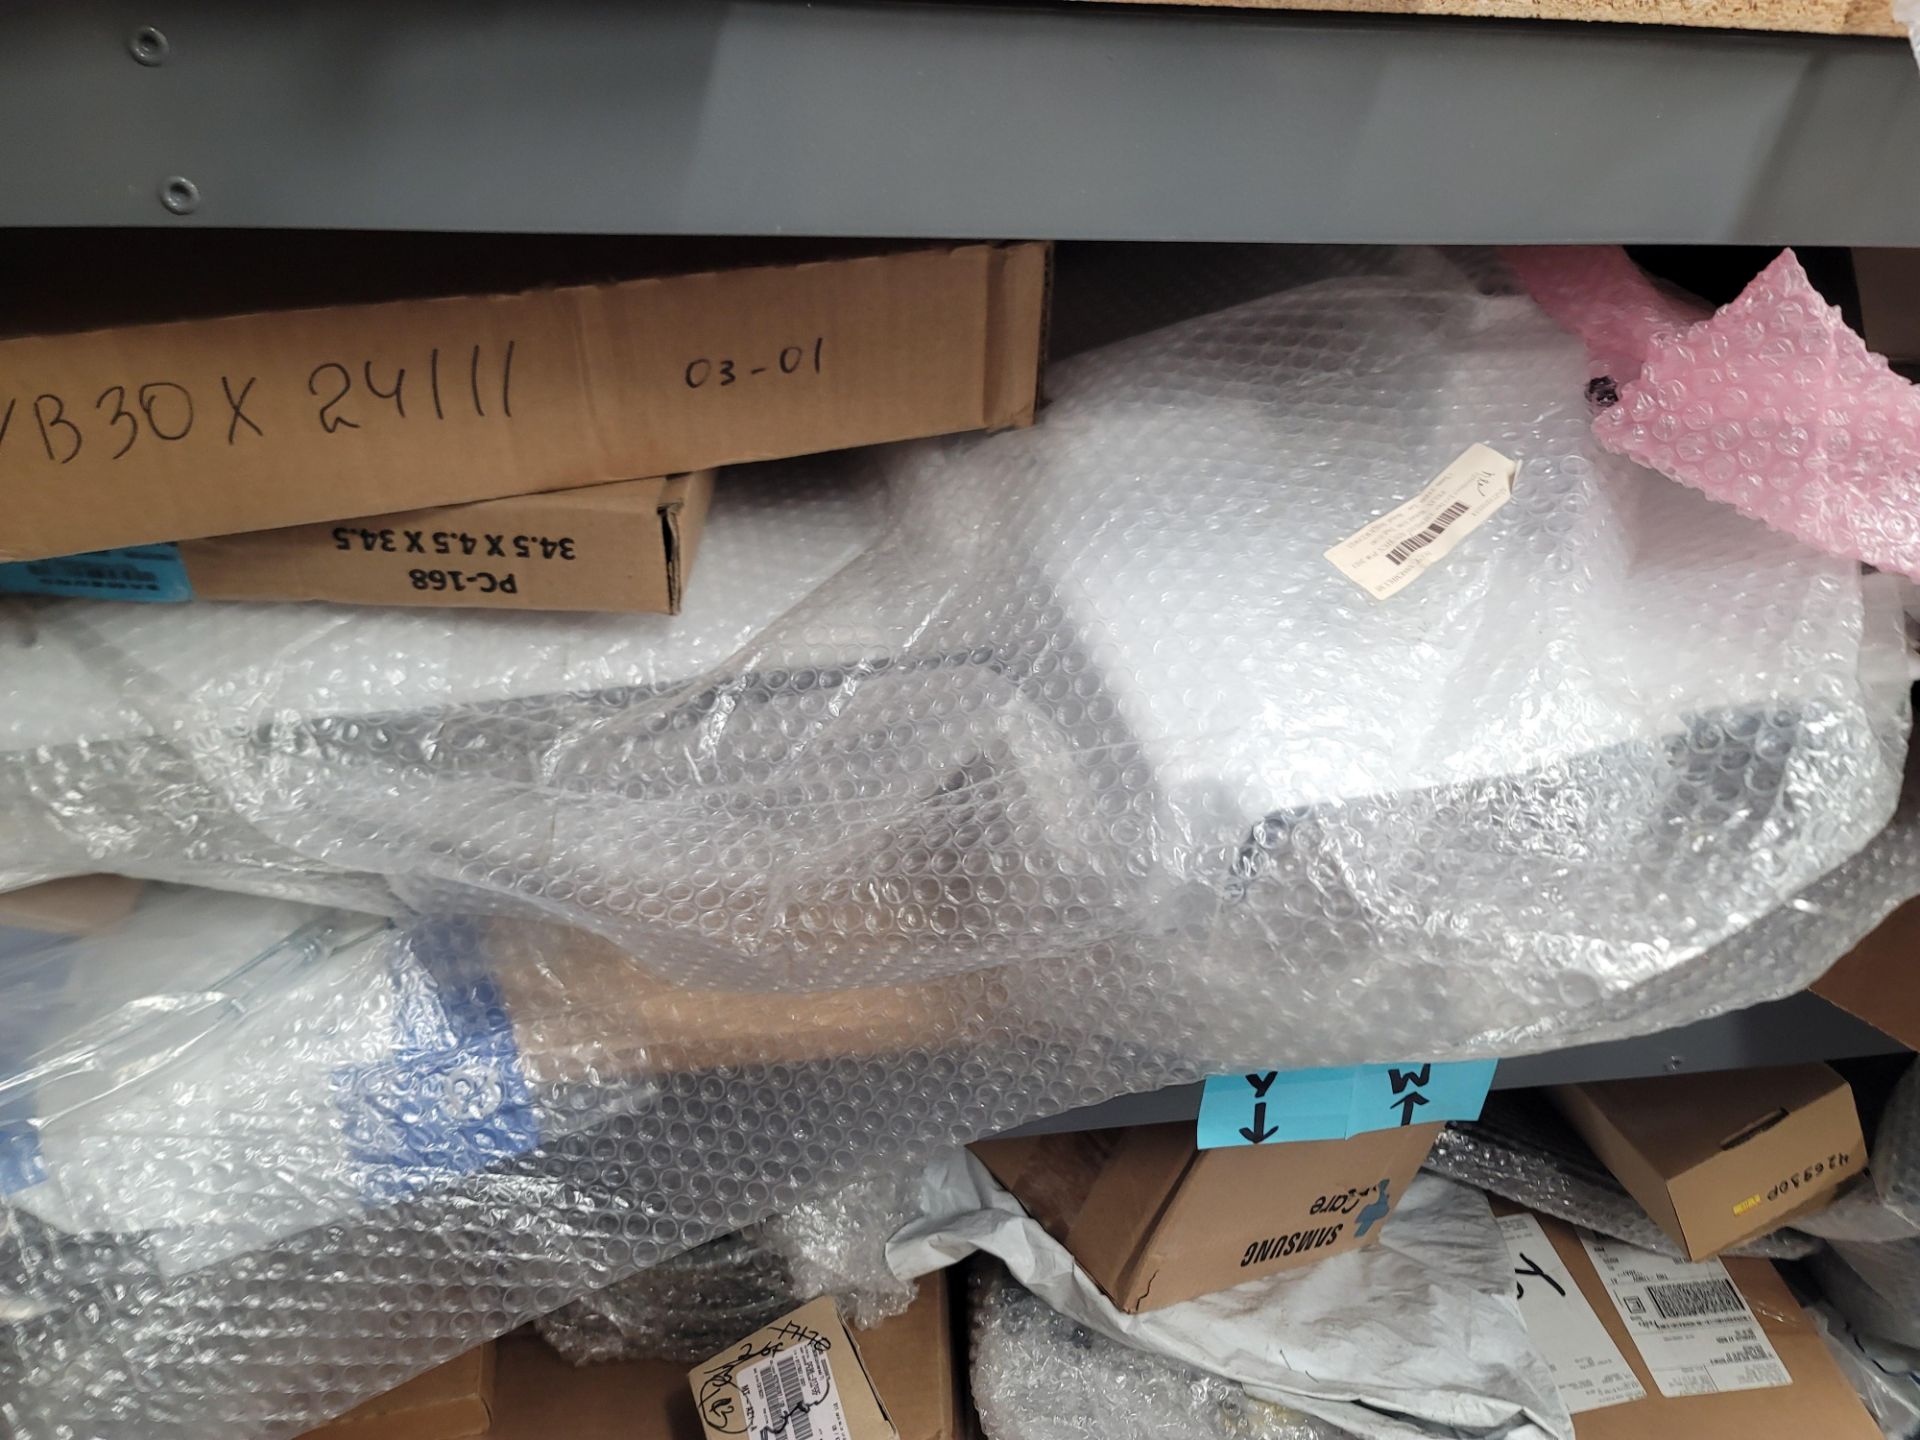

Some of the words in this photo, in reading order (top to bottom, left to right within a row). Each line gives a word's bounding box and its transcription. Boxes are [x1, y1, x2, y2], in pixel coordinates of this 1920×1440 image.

[685, 337, 823, 389] 03-01
[332, 527, 397, 552] 34.5
[403, 530, 426, 553] X
[432, 531, 477, 555] 4.5
[485, 533, 506, 558] X
[512, 535, 577, 561] 34.5
[408, 568, 519, 594] PC-168
[1245, 1070, 1279, 1099] Y
[1240, 1222, 1344, 1267] SAMSUNG
